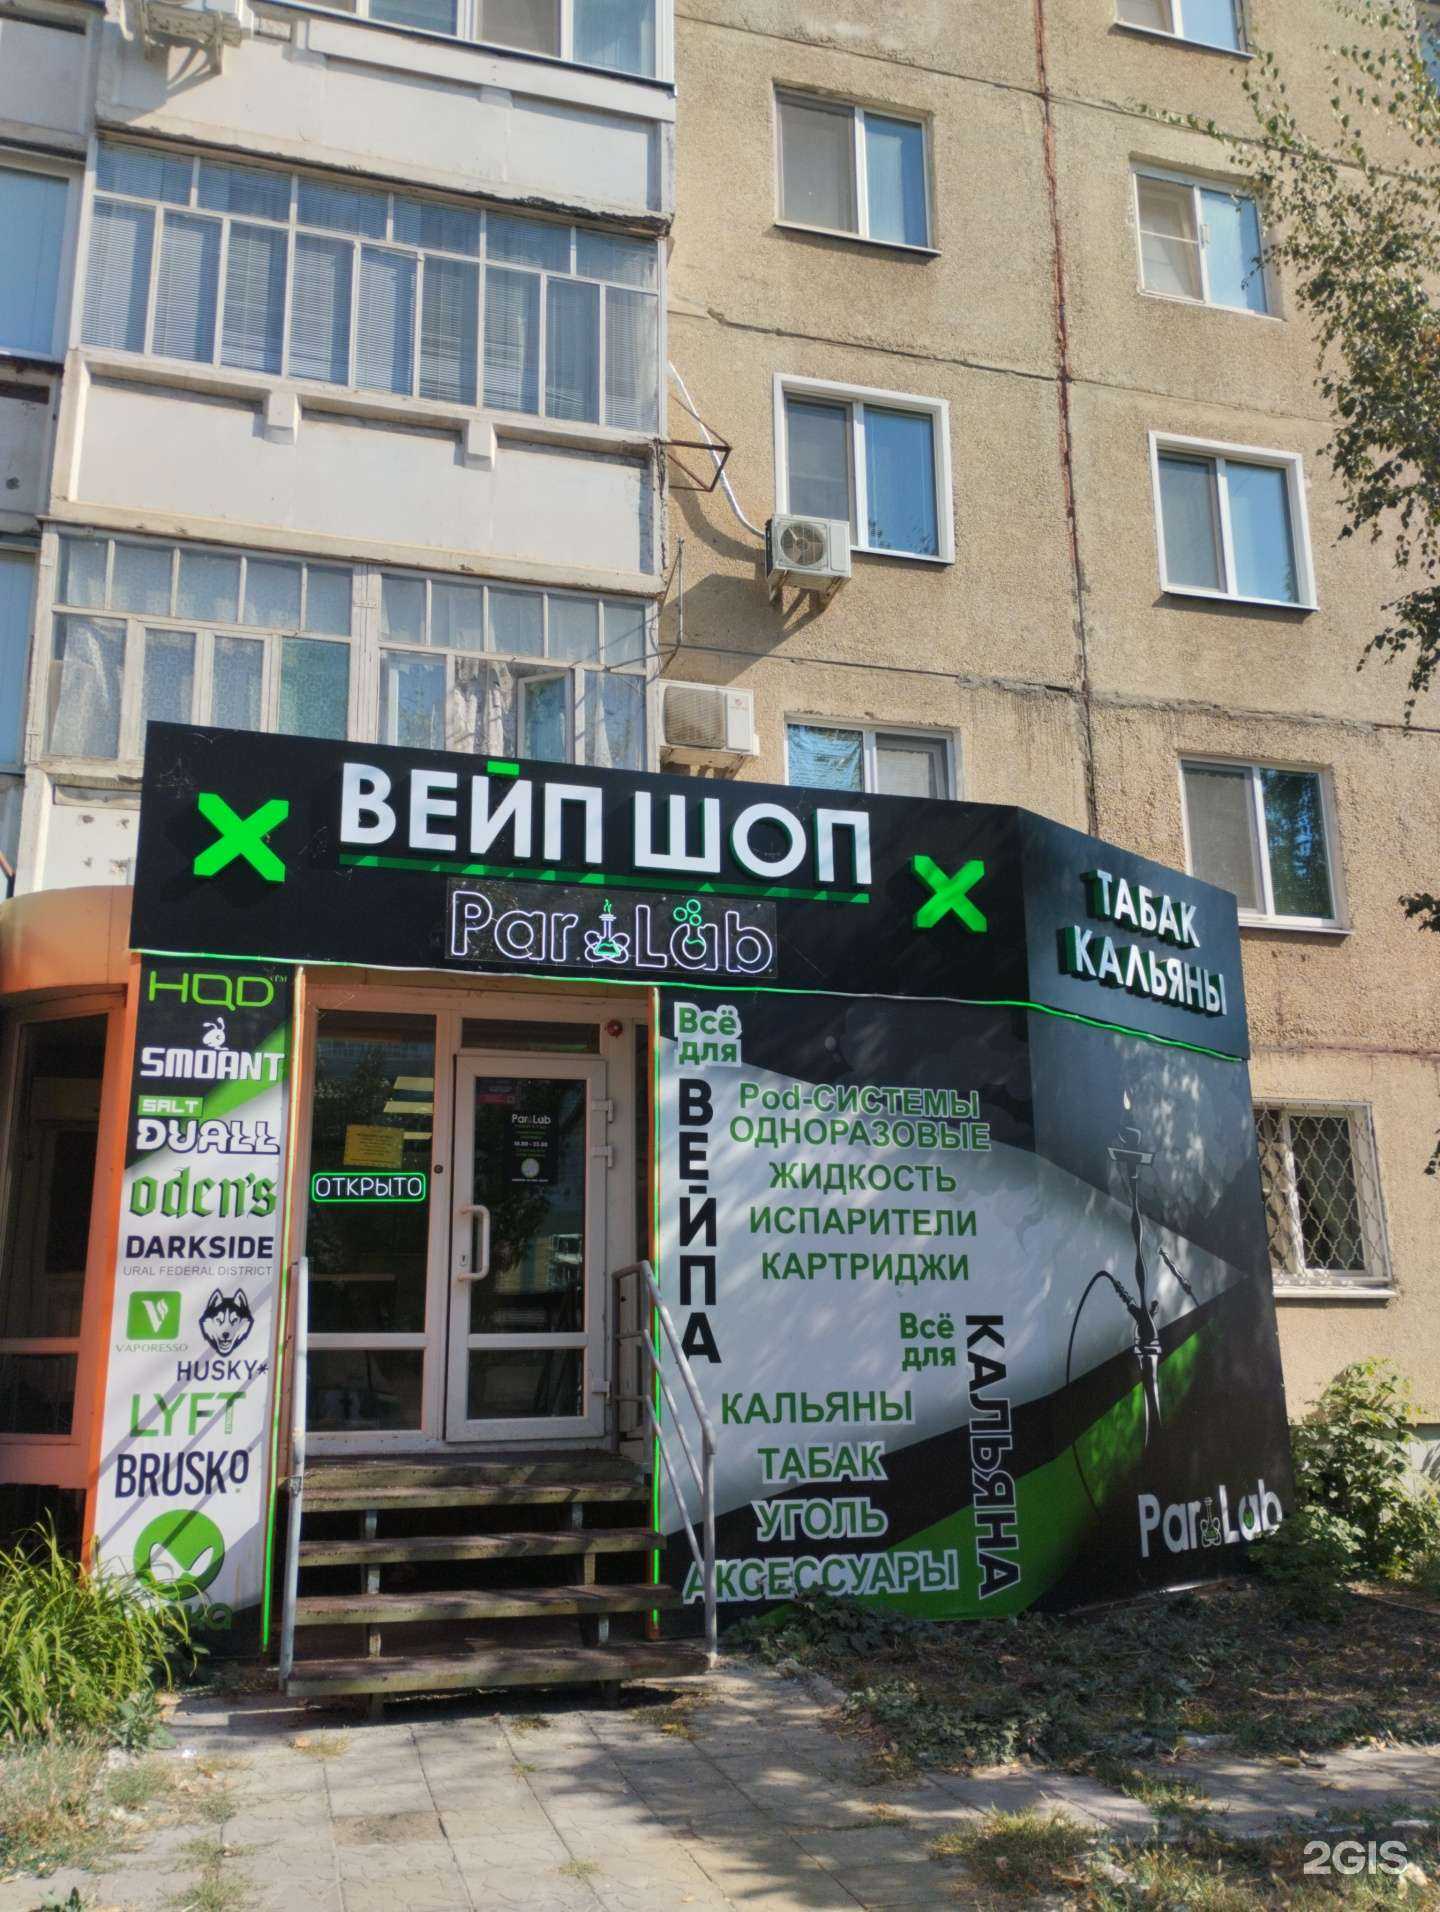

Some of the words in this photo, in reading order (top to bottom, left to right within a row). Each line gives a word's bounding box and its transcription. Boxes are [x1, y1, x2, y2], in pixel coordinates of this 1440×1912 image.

[340, 761, 603, 864] ВЕЙП
[633, 790, 873, 885] ШОП
[1094, 869, 1201, 948] ТАБАК
[451, 890, 579, 963] Par
[635, 902, 773, 974] Lab
[1070, 924, 1228, 1016] КАЛЬЯНЫ
[149, 970, 275, 1011] HQD
[678, 1006, 738, 1036] Всё
[140, 1047, 286, 1081] SMOANT
[678, 1041, 738, 1065] для
[141, 1098, 199, 1114] SALT
[738, 1082, 980, 1118] Pod-СИСТЕМЫ
[136, 1119, 281, 1154] DUALL
[729, 1116, 991, 1151] ОДНОРАЗОВЫЕ
[316, 1177, 423, 1198] ОТКРЫТО
[768, 1161, 957, 1195] ЖИДКОСТЬ
[678, 1077, 722, 1364] ВЕЙПА
[749, 1206, 978, 1237] ИСПАРИТЕЛИ
[125, 1235, 274, 1260] DARKSIDE
[123, 1265, 156, 1276] URAL
[159, 1265, 216, 1276] FEDERAL
[217, 1265, 273, 1276] DISTRICT
[761, 1252, 970, 1286] КАРТРИДЖИ
[899, 1311, 955, 1340] Всё
[115, 1343, 189, 1353] VAPORESSO
[902, 1346, 956, 1371] для
[129, 1391, 247, 1438] LYFT
[721, 1390, 913, 1425] КАЛЬЯНЫ
[114, 1449, 250, 1498] BRUSKO
[757, 1444, 885, 1480] ТАБАК
[965, 1314, 1021, 1599] КАЛЬЯНА
[756, 1499, 888, 1538] УГОЛЬ
[1137, 1493, 1201, 1558] Par
[1218, 1479, 1283, 1544] Lab
[685, 1551, 957, 1602] АКСЕССУАРЫ
